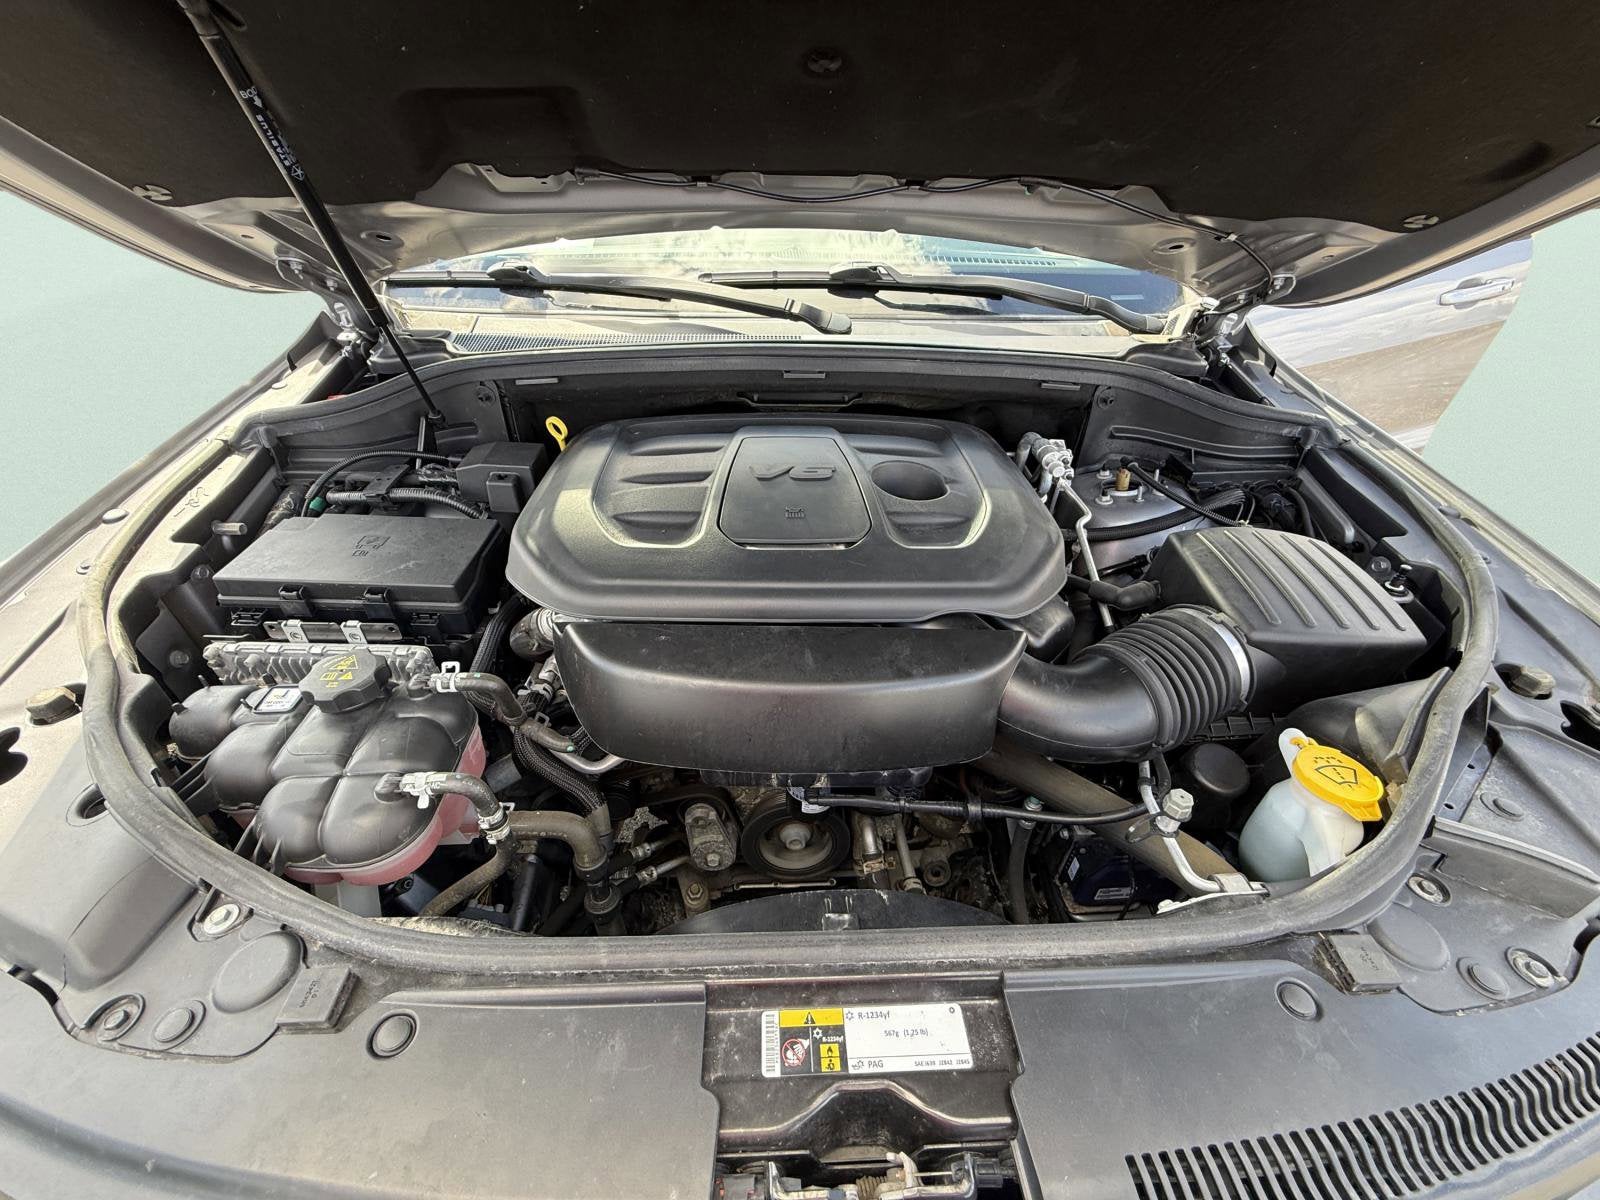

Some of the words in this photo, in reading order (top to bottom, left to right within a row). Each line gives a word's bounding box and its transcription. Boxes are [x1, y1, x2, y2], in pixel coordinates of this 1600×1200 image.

[256, 114, 291, 167] STABILUS
[749, 465, 837, 481] V6
[858, 1010, 890, 1020] R-1234yf
[884, 1029, 900, 1038] 567g
[868, 1060, 884, 1069] PAG
